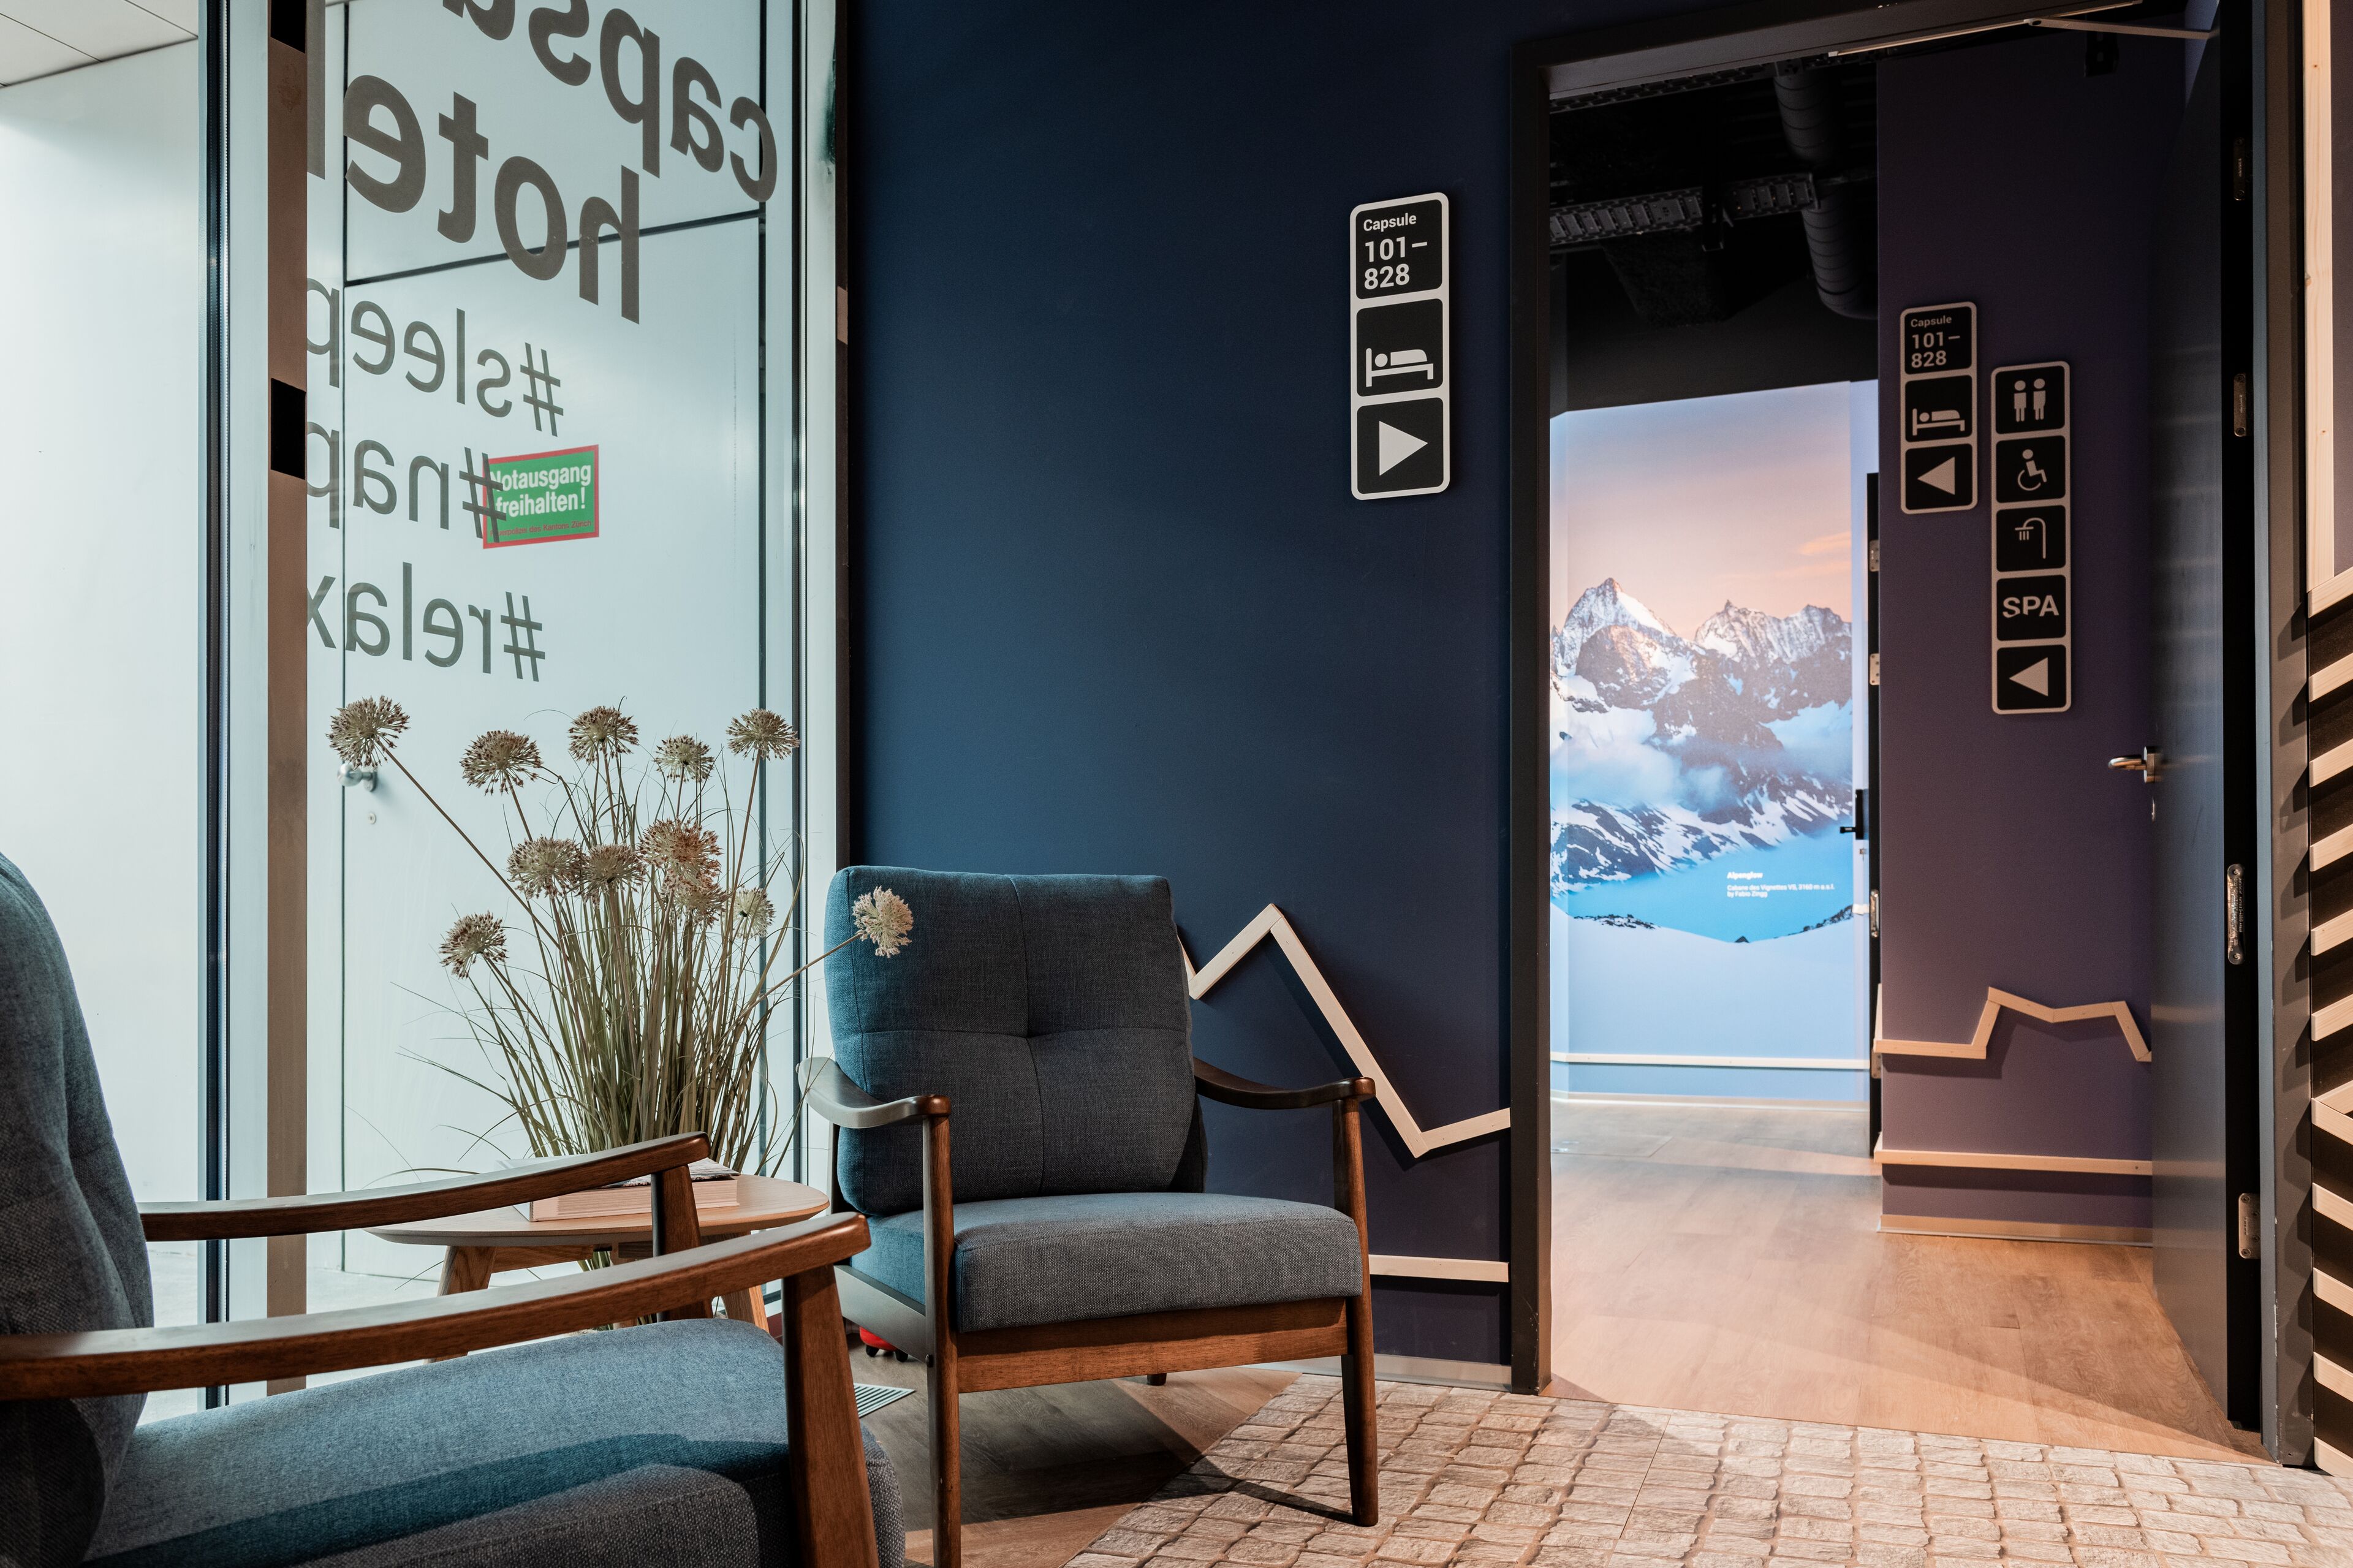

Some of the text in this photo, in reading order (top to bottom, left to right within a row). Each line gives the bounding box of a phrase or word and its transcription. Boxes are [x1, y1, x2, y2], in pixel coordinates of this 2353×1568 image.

[1363, 212, 1417, 232] Capsule
[1364, 263, 1410, 290] 828
[1911, 314, 1952, 328] Capsule
[1911, 350, 1947, 368] 828
[544, 523, 569, 531] Kantons
[571, 520, 592, 529] Zürich
[2002, 594, 2059, 618] SPA
[1727, 871, 1763, 880] Alpenglow
